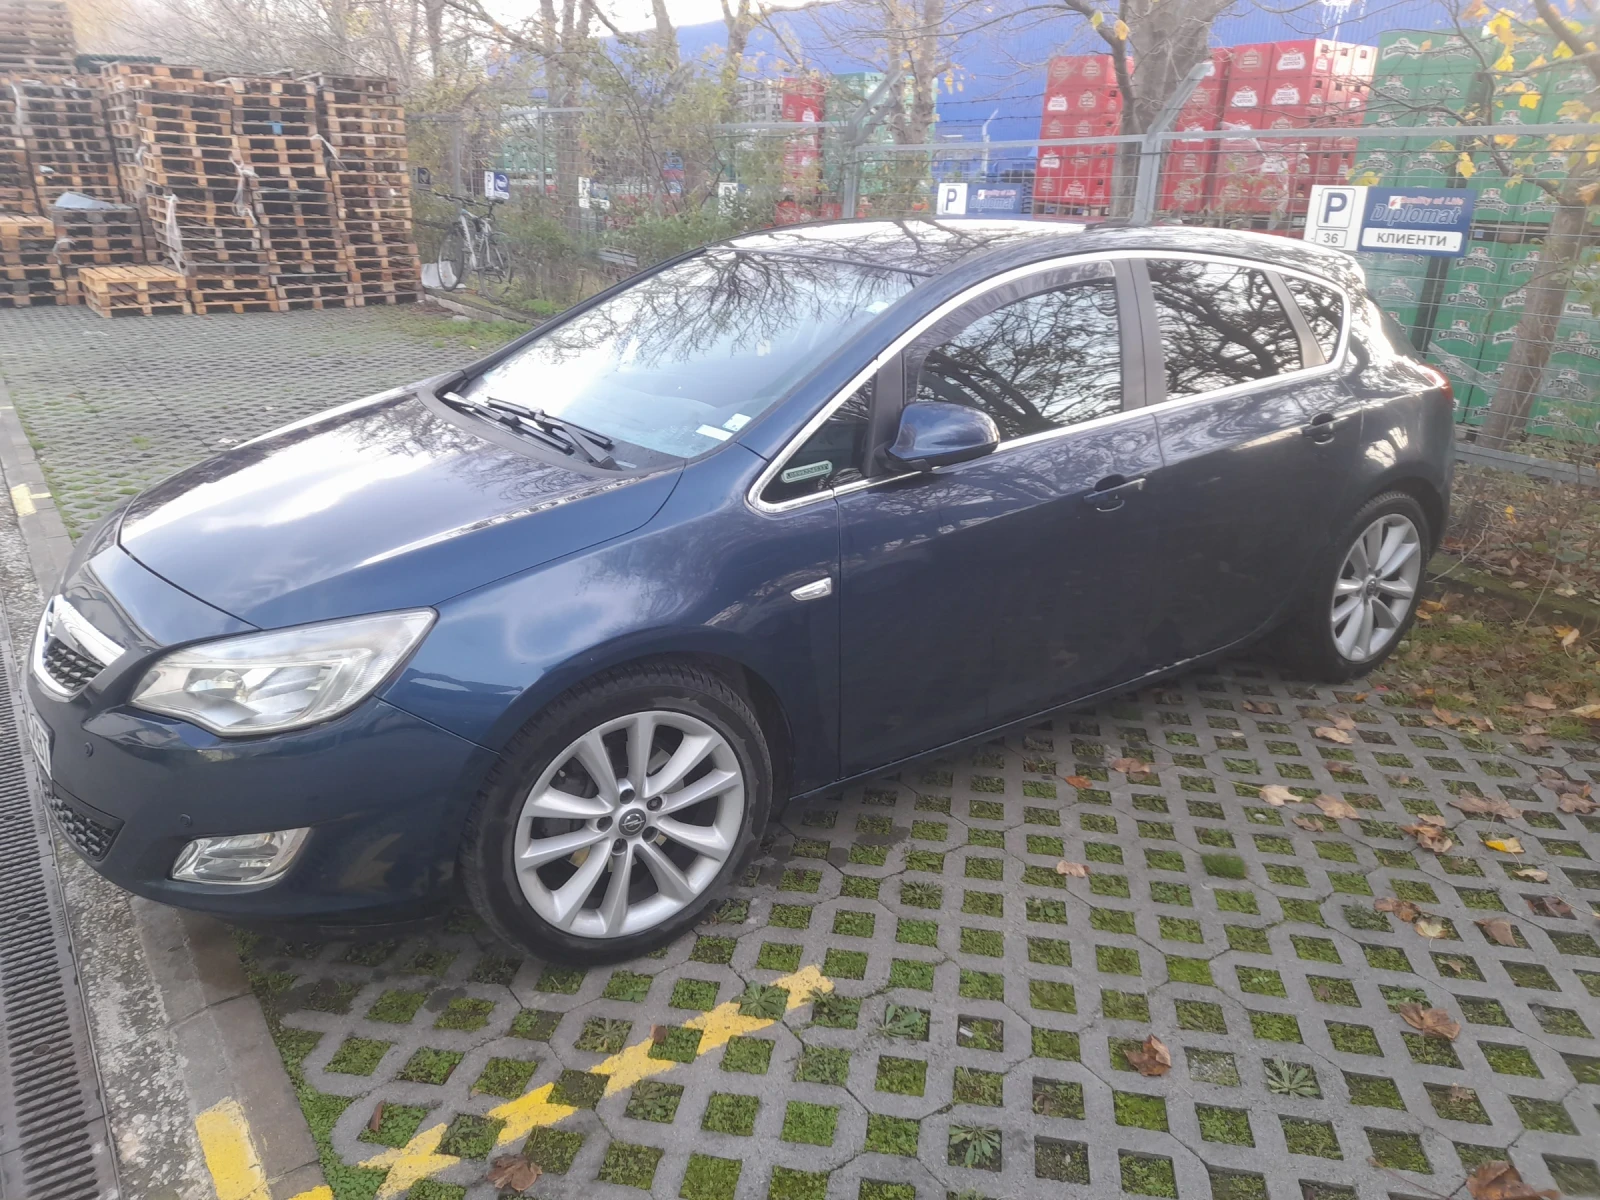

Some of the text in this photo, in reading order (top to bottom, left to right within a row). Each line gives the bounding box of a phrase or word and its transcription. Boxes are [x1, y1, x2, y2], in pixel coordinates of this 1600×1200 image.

[945, 188, 957, 211] P
[1323, 192, 1348, 223] P
[1370, 203, 1462, 226] Diplomat
[1323, 232, 1339, 244] 36
[1376, 232, 1447, 247] КЛИЕНТИ
